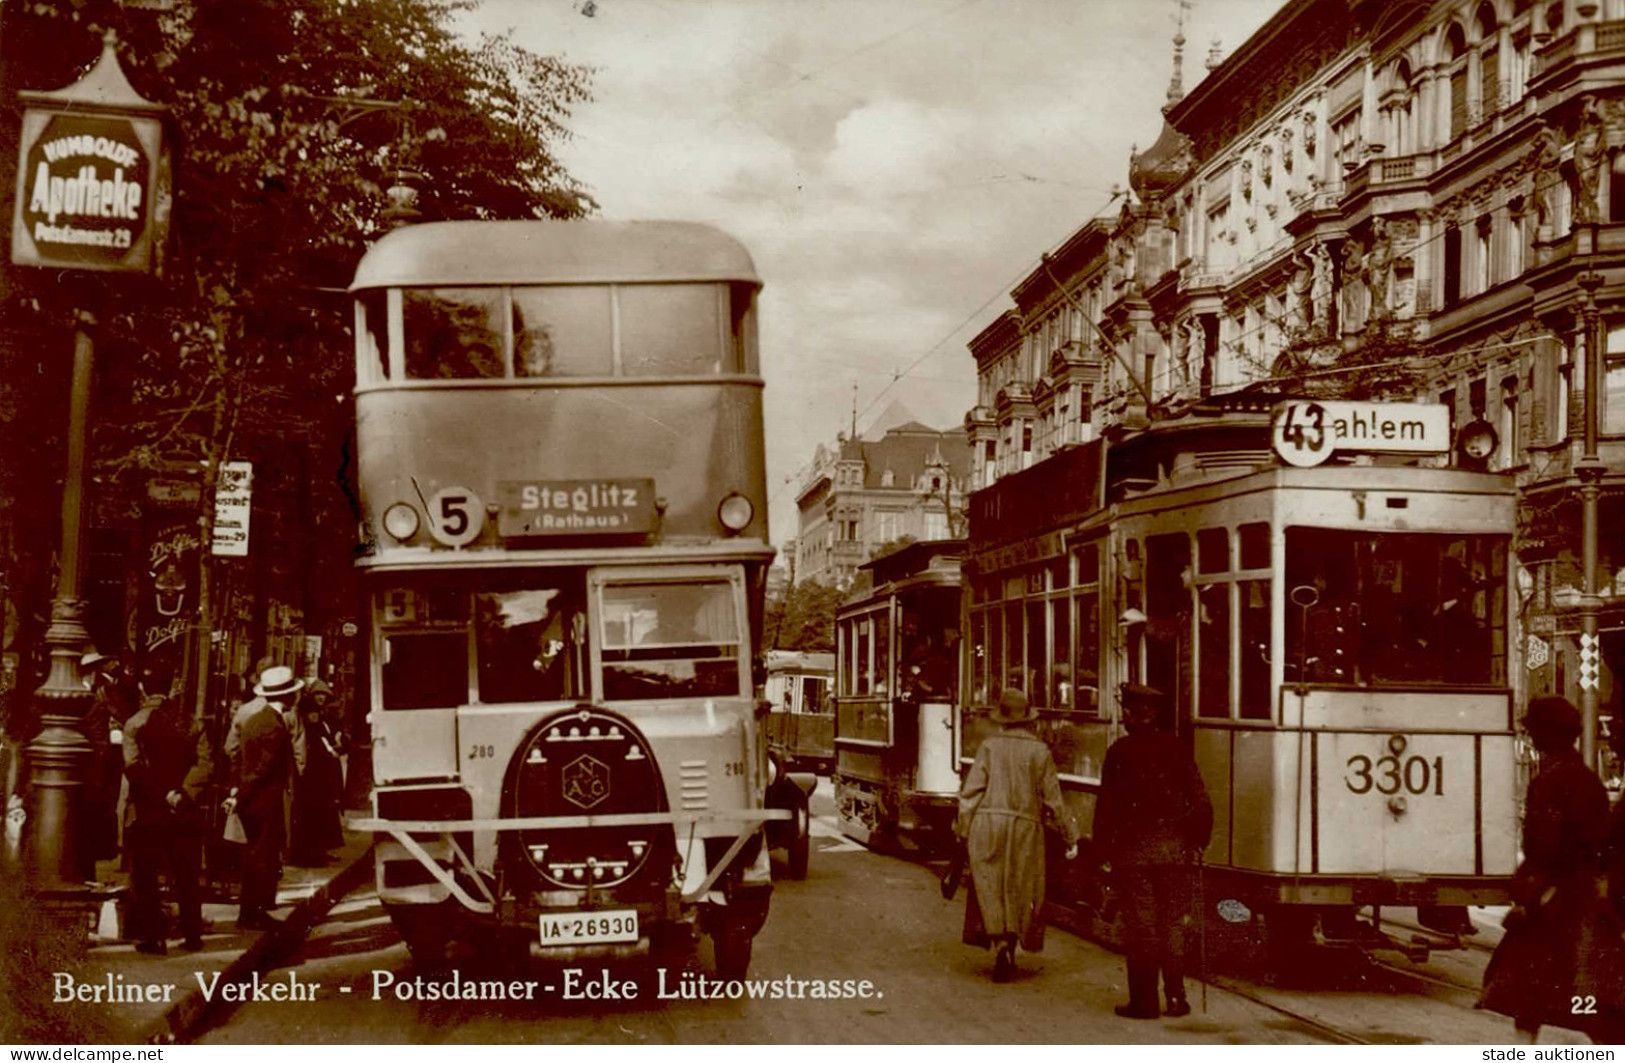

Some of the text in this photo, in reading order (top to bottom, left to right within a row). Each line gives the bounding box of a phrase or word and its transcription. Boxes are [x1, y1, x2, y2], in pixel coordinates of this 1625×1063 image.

[29, 161, 142, 223] Apotheke
[1282, 402, 1325, 452] 43
[1333, 410, 1425, 440] ahlem
[521, 483, 638, 512] Steglitz
[439, 496, 469, 537] 5
[534, 512, 629, 529] (Rathaus)
[391, 591, 407, 618] 5
[468, 744, 494, 760] 280
[1344, 754, 1445, 796] 3301
